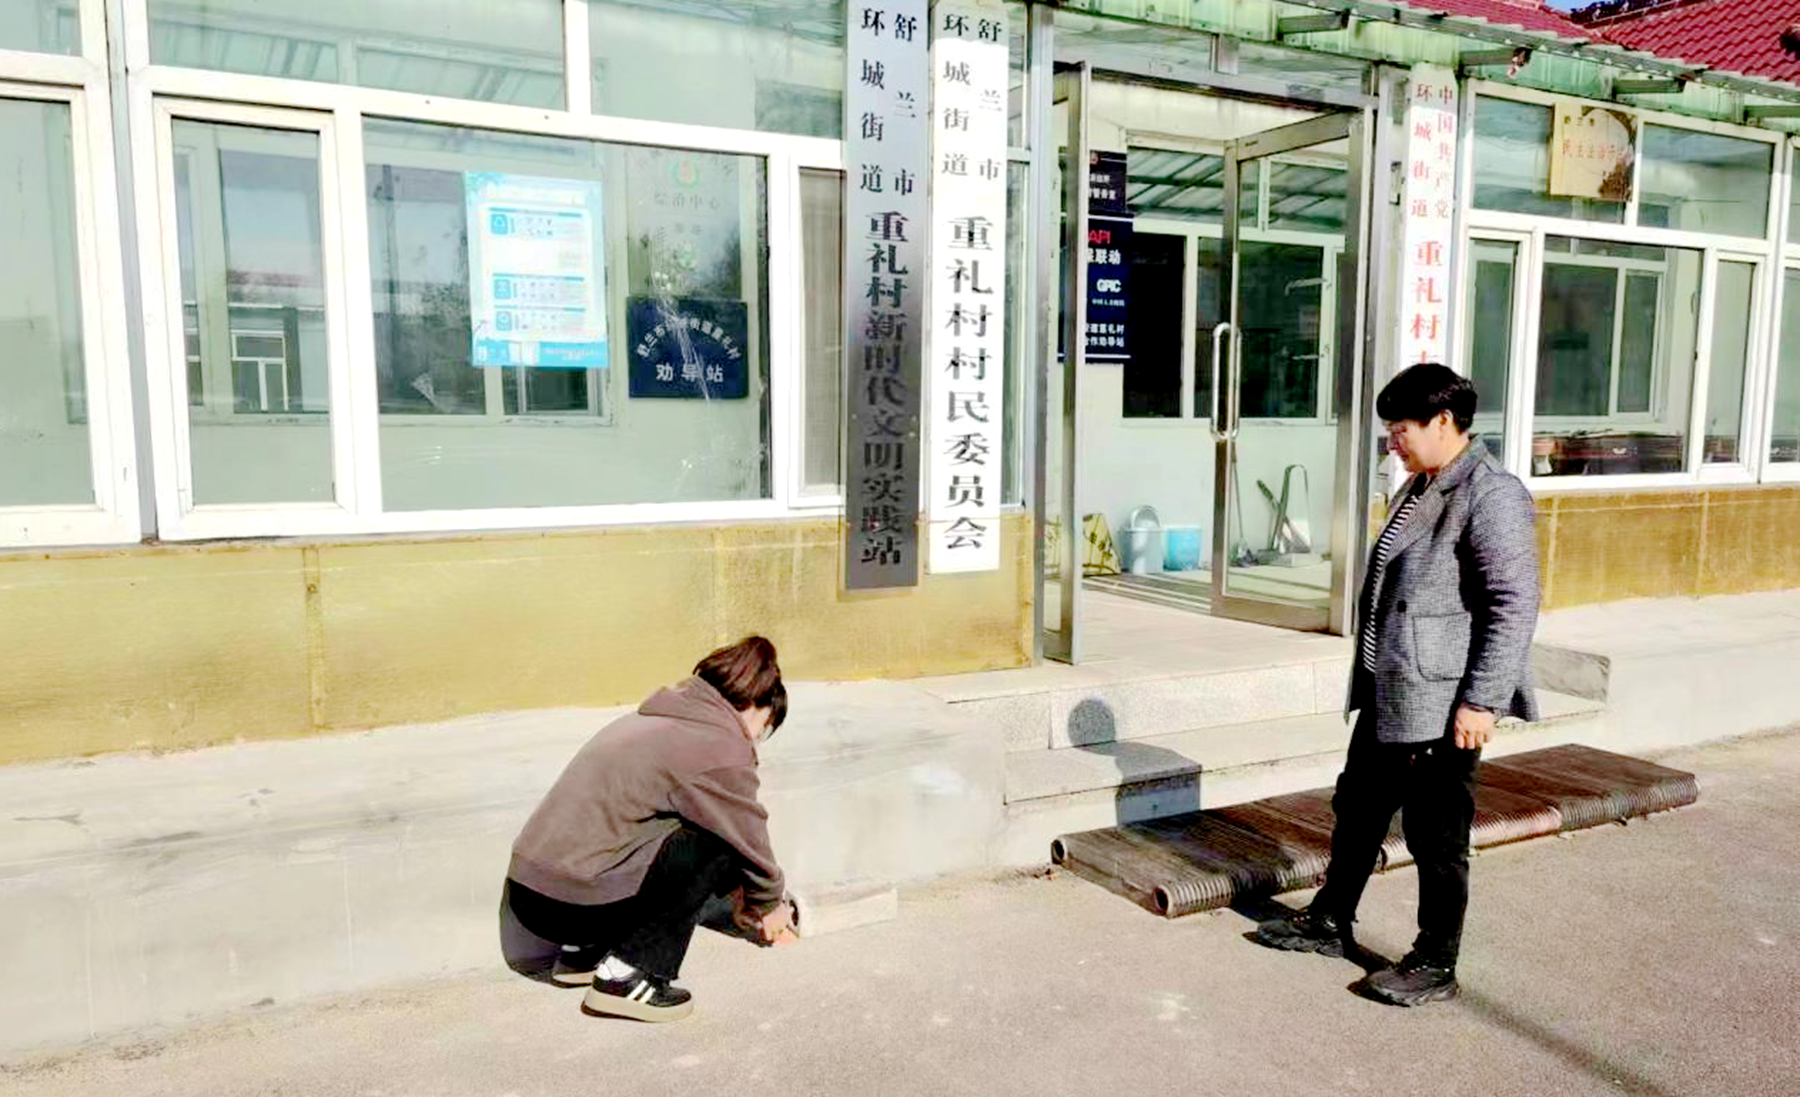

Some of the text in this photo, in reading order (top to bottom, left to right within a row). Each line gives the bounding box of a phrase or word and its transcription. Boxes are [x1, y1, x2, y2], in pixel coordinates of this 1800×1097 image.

[860, 7, 886, 195] 环城街道
[893, 13, 918, 196] 舒兰市
[941, 12, 972, 178] 环城街道
[977, 17, 1003, 182] 舒兰市
[1411, 83, 1433, 217] 环城街道
[1435, 86, 1454, 219] 中国共产党
[656, 362, 724, 383] 劝导站
[860, 210, 909, 566] 重礼村新时代文明实践站
[943, 215, 994, 550] 重礼村村民委员会
